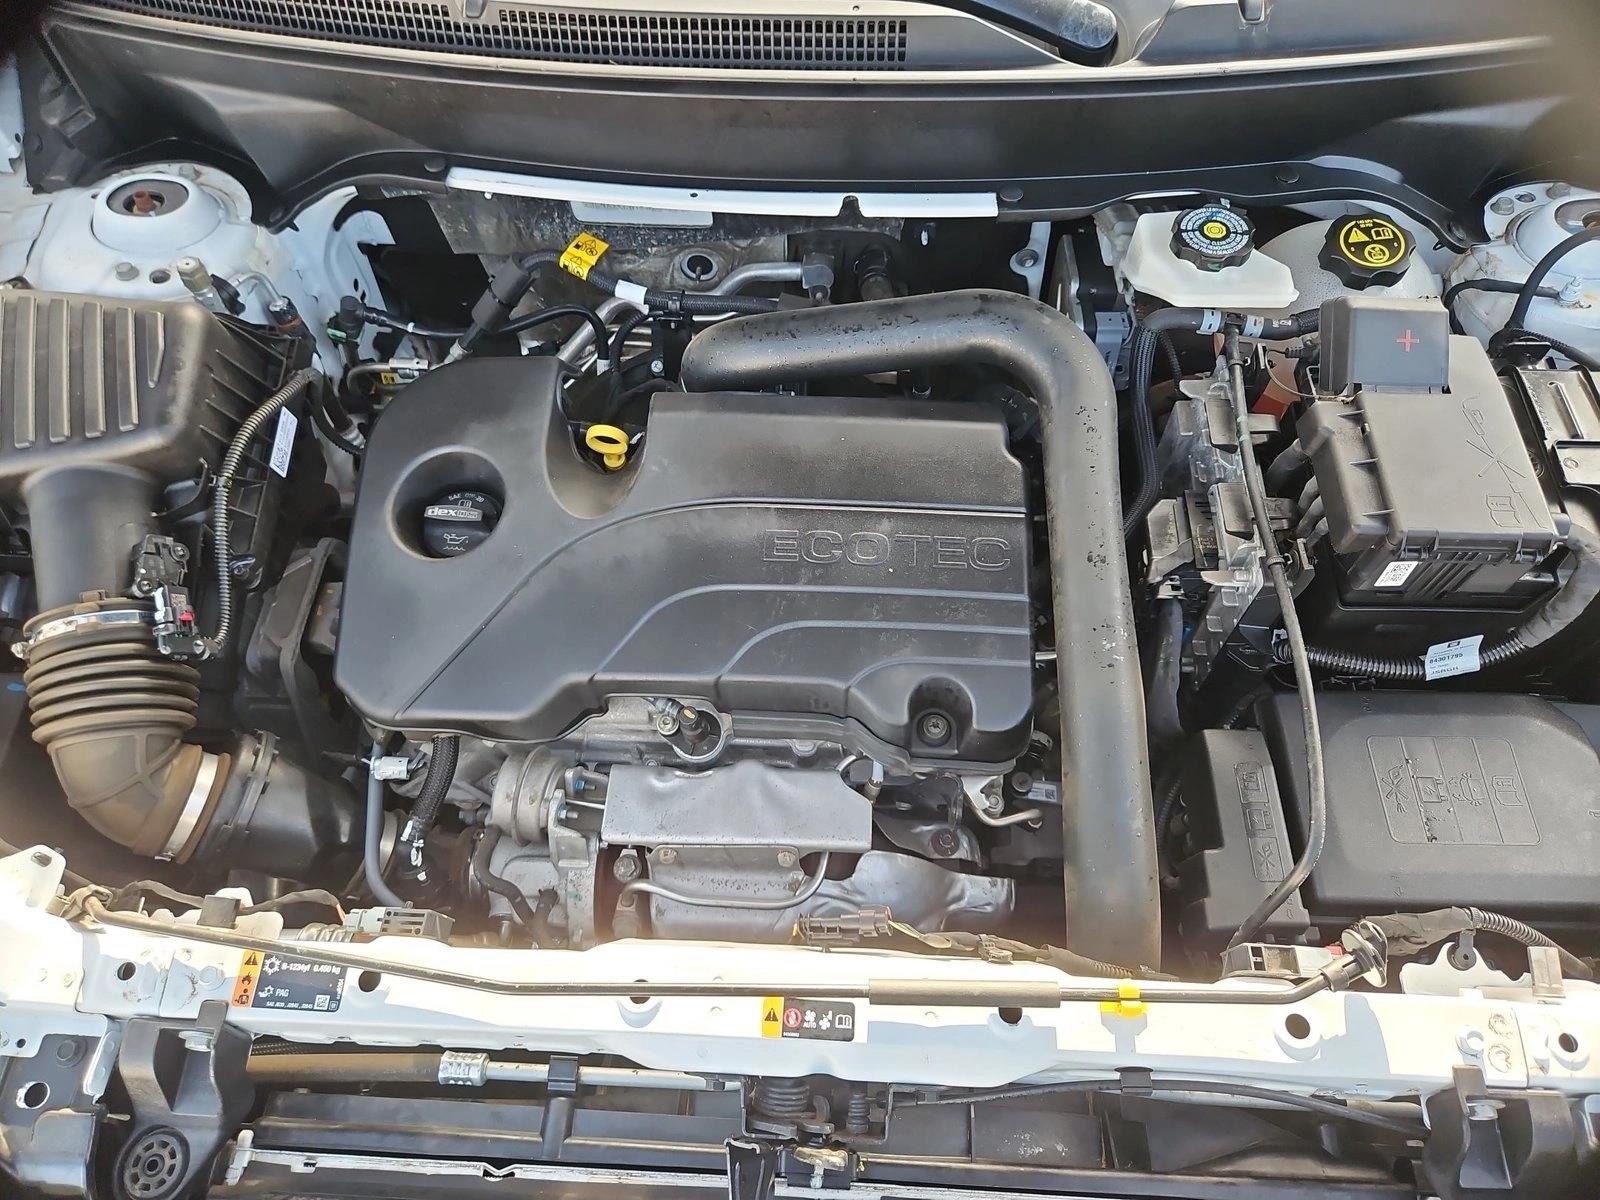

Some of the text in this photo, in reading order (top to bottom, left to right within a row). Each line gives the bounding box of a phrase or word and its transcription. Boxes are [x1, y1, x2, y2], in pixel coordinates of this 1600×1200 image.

[428, 507, 478, 519] dexos
[763, 529, 1011, 572] ECOTEC
[275, 989, 289, 997] PAG
